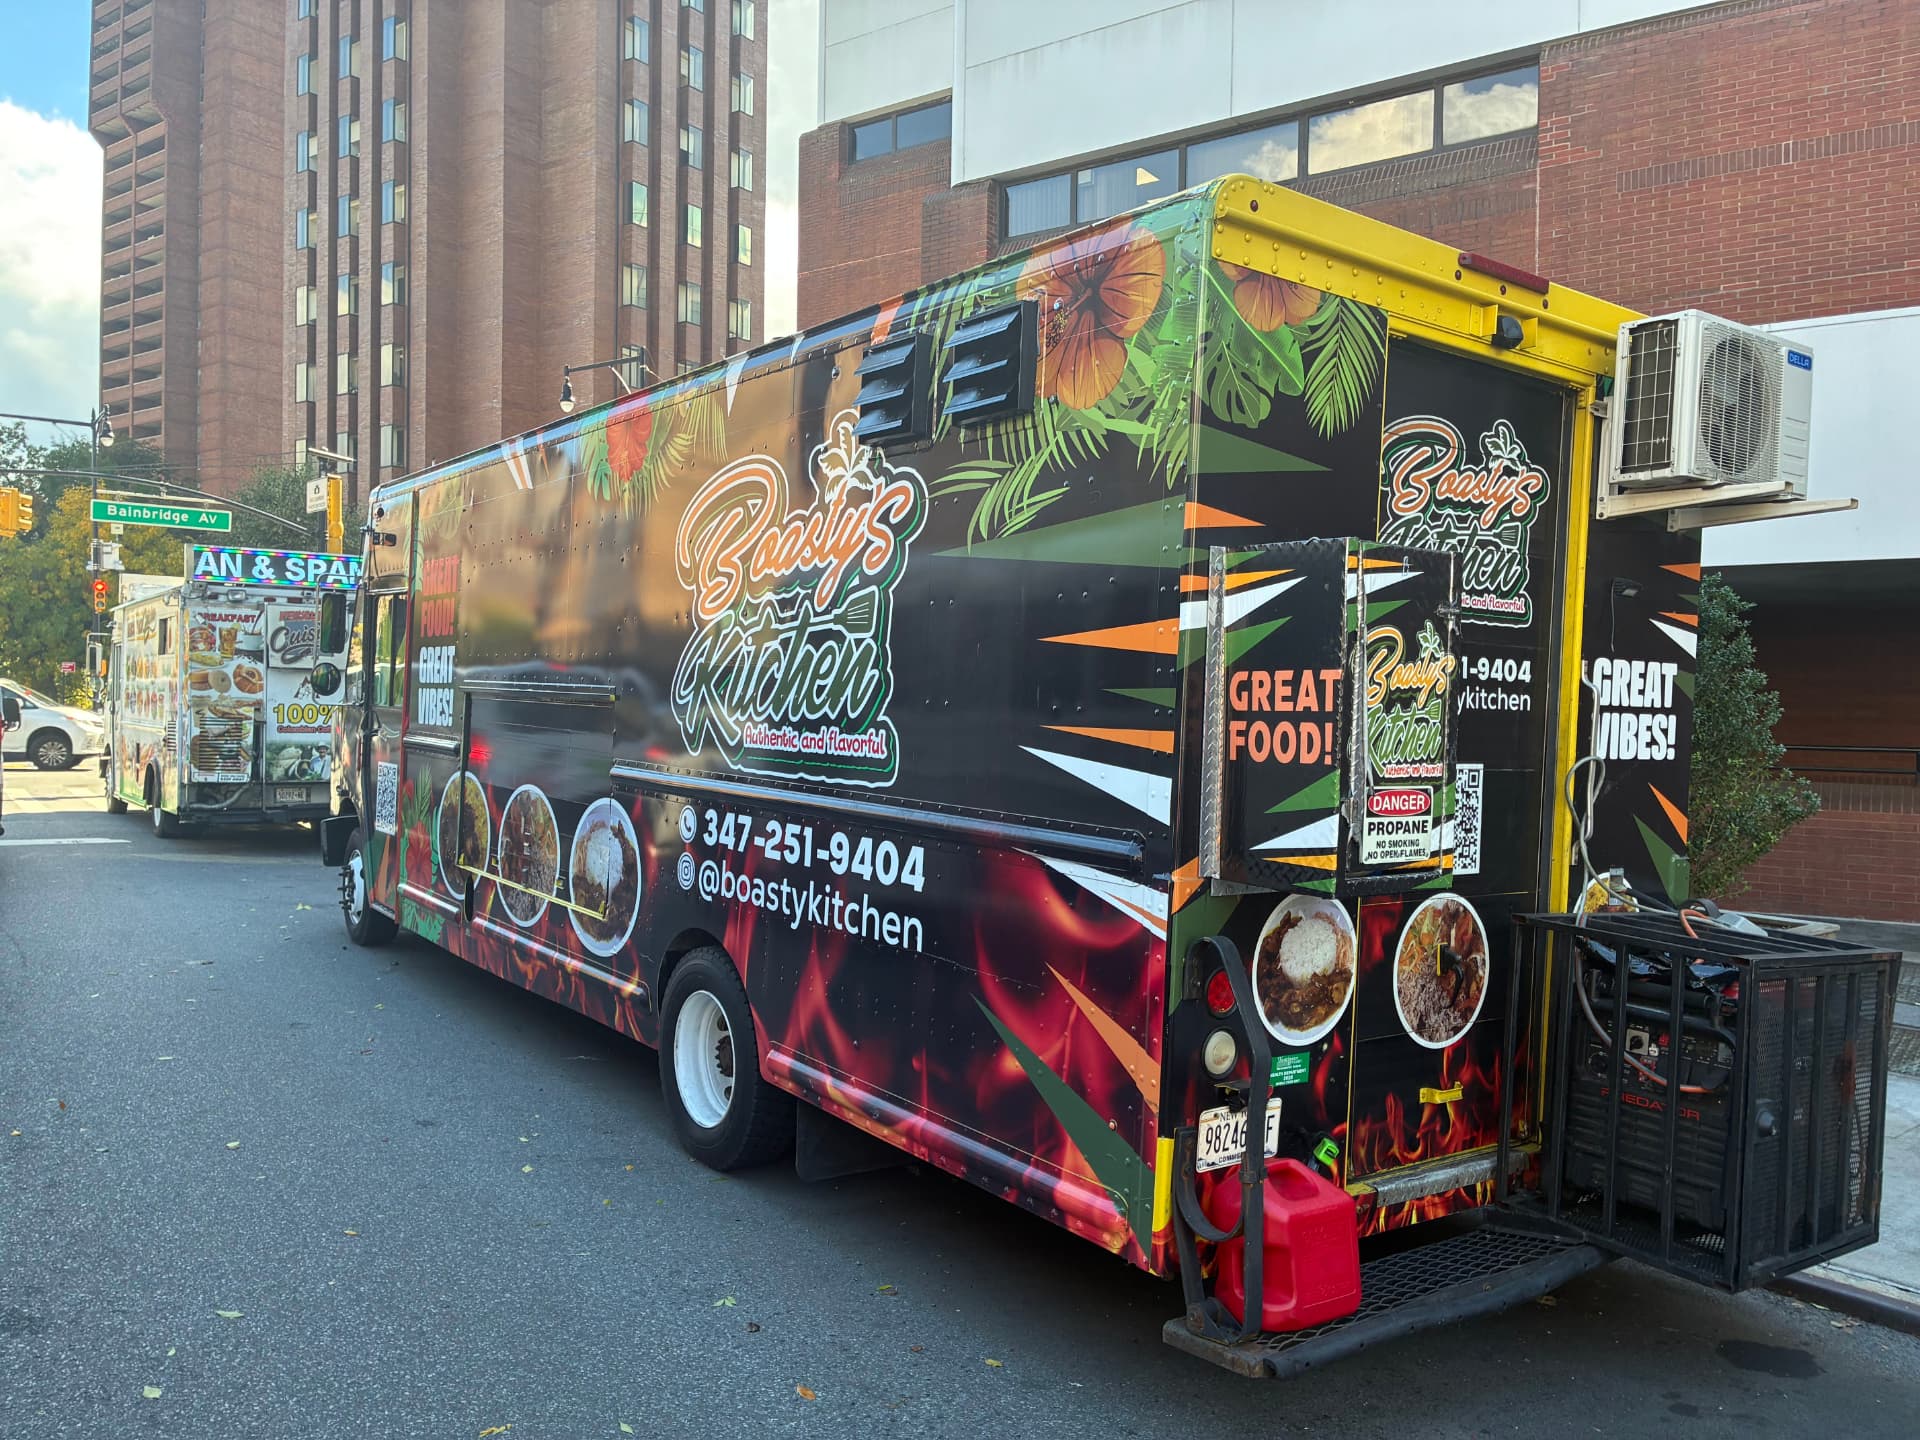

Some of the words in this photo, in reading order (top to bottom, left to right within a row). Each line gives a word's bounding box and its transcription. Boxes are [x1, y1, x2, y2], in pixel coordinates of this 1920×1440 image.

[1789, 353, 1809, 369] DELLA
[107, 504, 189, 524] Bainbridge
[195, 552, 241, 577] AN
[252, 556, 276, 579] &
[421, 555, 459, 596] GREAT
[420, 598, 455, 638] FOOD!
[1471, 596, 1488, 609] and
[1488, 594, 1526, 613] flavorful
[419, 646, 456, 684] GREAT
[676, 600, 879, 745] Kitchen
[1461, 656, 1531, 683] 1-9404
[1593, 657, 1678, 708] GREAT
[417, 688, 454, 727] VIBES!
[1229, 669, 1343, 712] GREAT
[1457, 685, 1531, 716] ykitchen
[744, 722, 798, 751] Authentic
[800, 726, 827, 753] and
[828, 726, 887, 759] flavorful
[1229, 720, 1334, 765] FOOD!
[1367, 702, 1442, 777] Kitchen
[1596, 712, 1677, 760] VIBES!
[1373, 795, 1425, 811] DANGER
[1368, 819, 1429, 836] PROPANE
[1376, 840, 1386, 848] NO
[1388, 838, 1420, 849] SMOKING
[703, 808, 925, 892] 347-251-9404
[1367, 852, 1378, 860] NO
[1380, 850, 1399, 859] OPEN
[1400, 848, 1426, 858] FLAMES
[698, 859, 924, 953] @boastykitchen
[1220, 1111, 1238, 1122] NEW
[1600, 1087, 1700, 1120] PEDAOR
